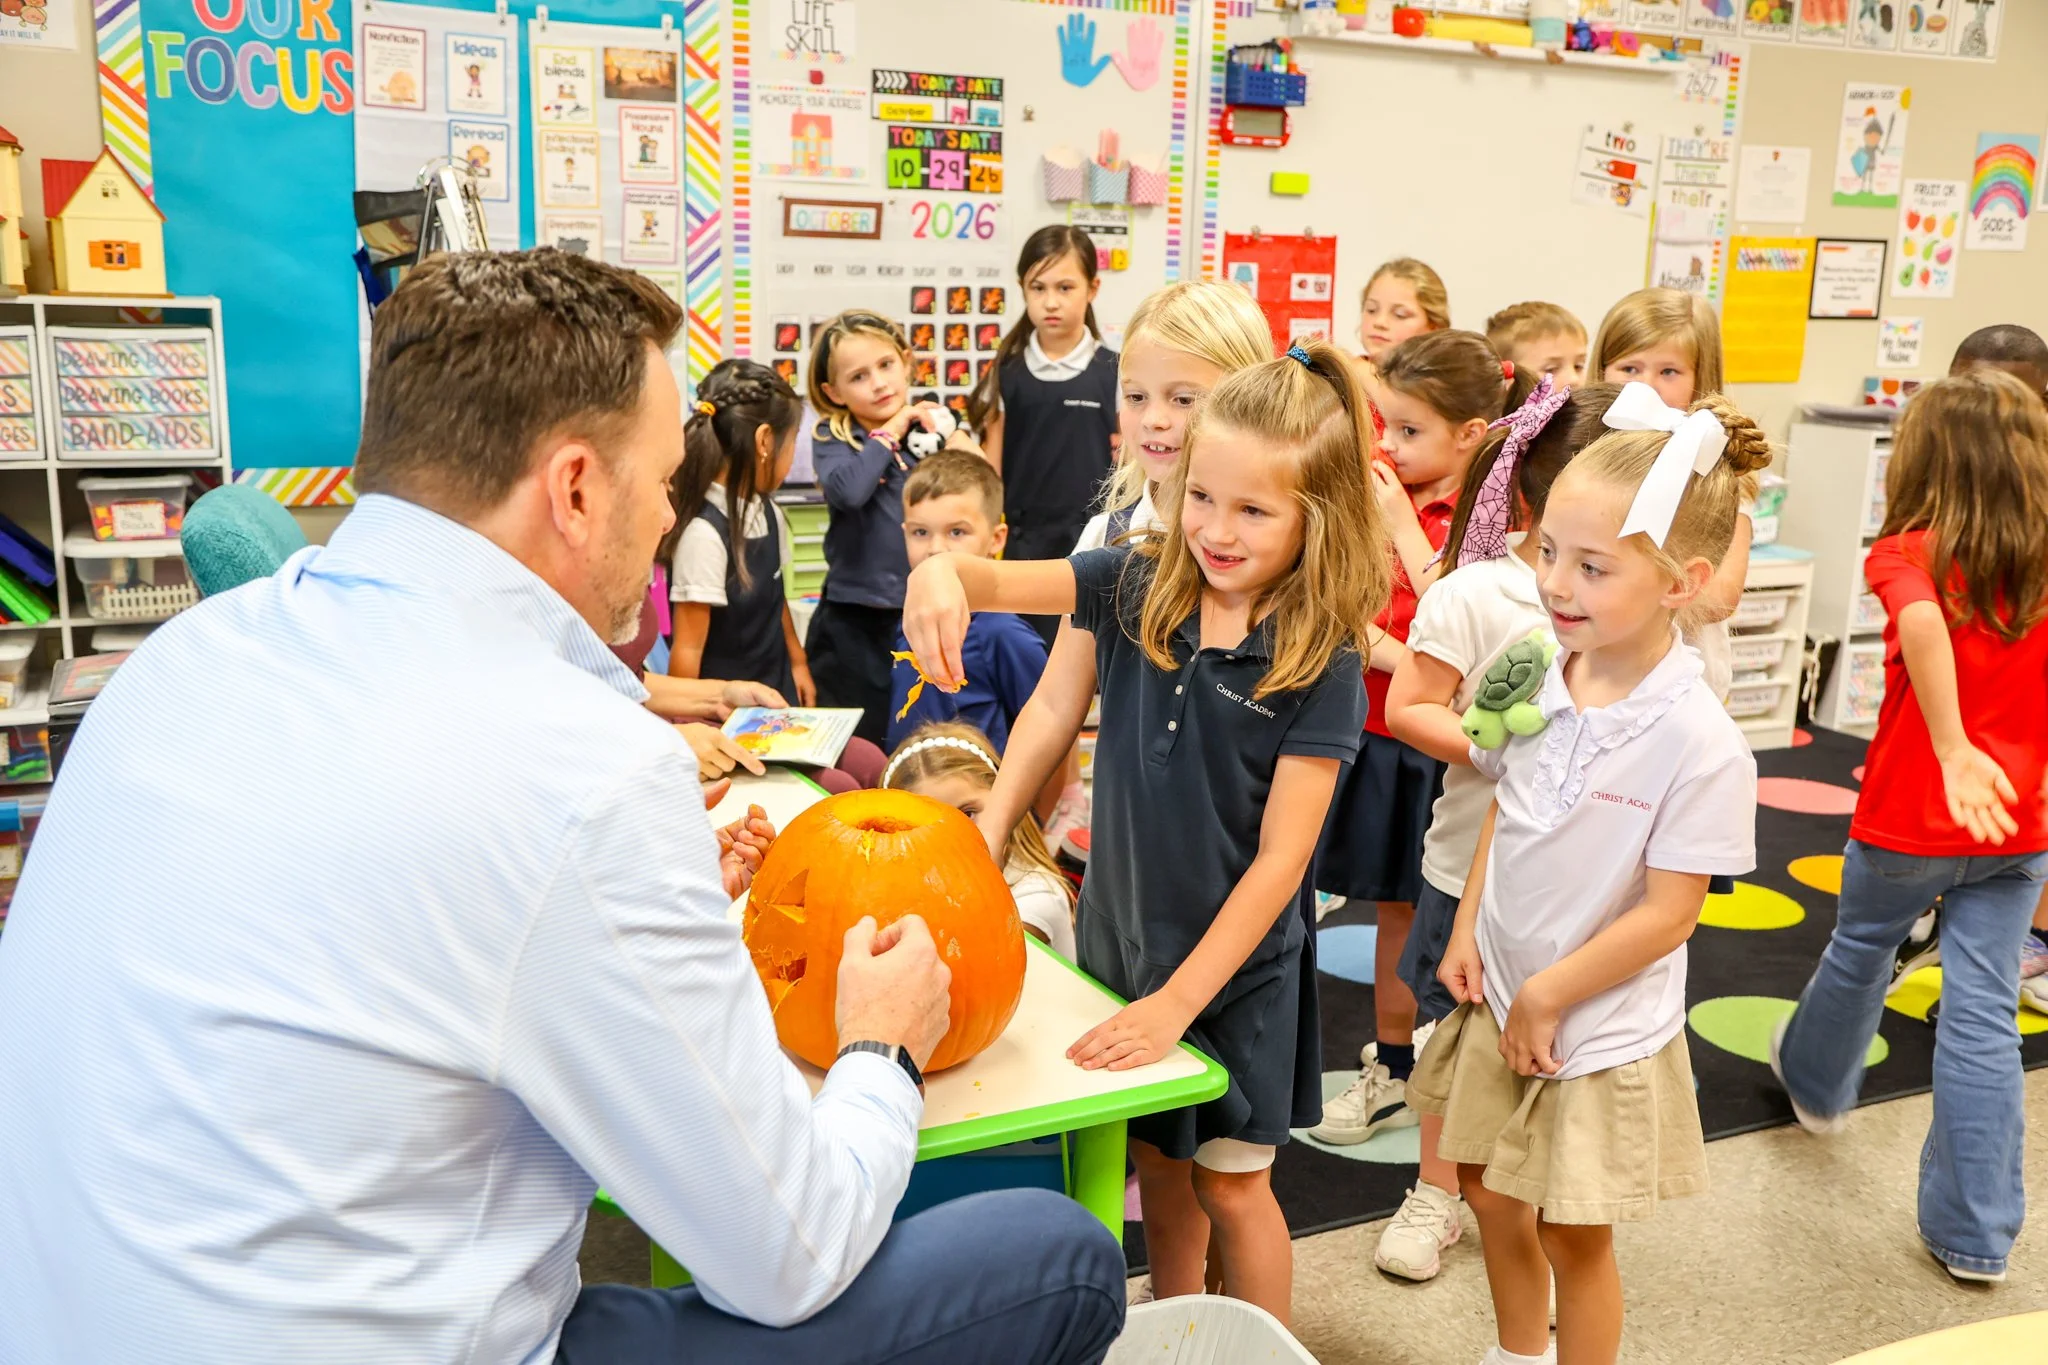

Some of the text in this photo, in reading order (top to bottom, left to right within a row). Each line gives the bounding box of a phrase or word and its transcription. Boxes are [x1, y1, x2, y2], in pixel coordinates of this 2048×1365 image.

[194, 0, 341, 41] OUR
[791, 0, 834, 28] LIFE
[453, 41, 498, 58] Ideas
[785, 25, 841, 54] SKILL
[553, 53, 577, 65] End
[149, 31, 355, 115] FOCUS
[967, 78, 1000, 95] DATE
[453, 125, 504, 141] Reread
[960, 132, 1000, 151] DATE
[1604, 131, 1637, 153] two
[893, 159, 1000, 183] 10 29 26
[796, 209, 871, 232] OCTOBER
[911, 201, 996, 240] 2026
[59, 351, 201, 369] DRAWING BOOKS
[64, 386, 204, 405] DRAWING BOOKS
[70, 420, 203, 446] BAND-AIDS
[1216, 683, 1276, 719] CHRIST ACADEMY
[1591, 791, 1624, 804] CHRIST
